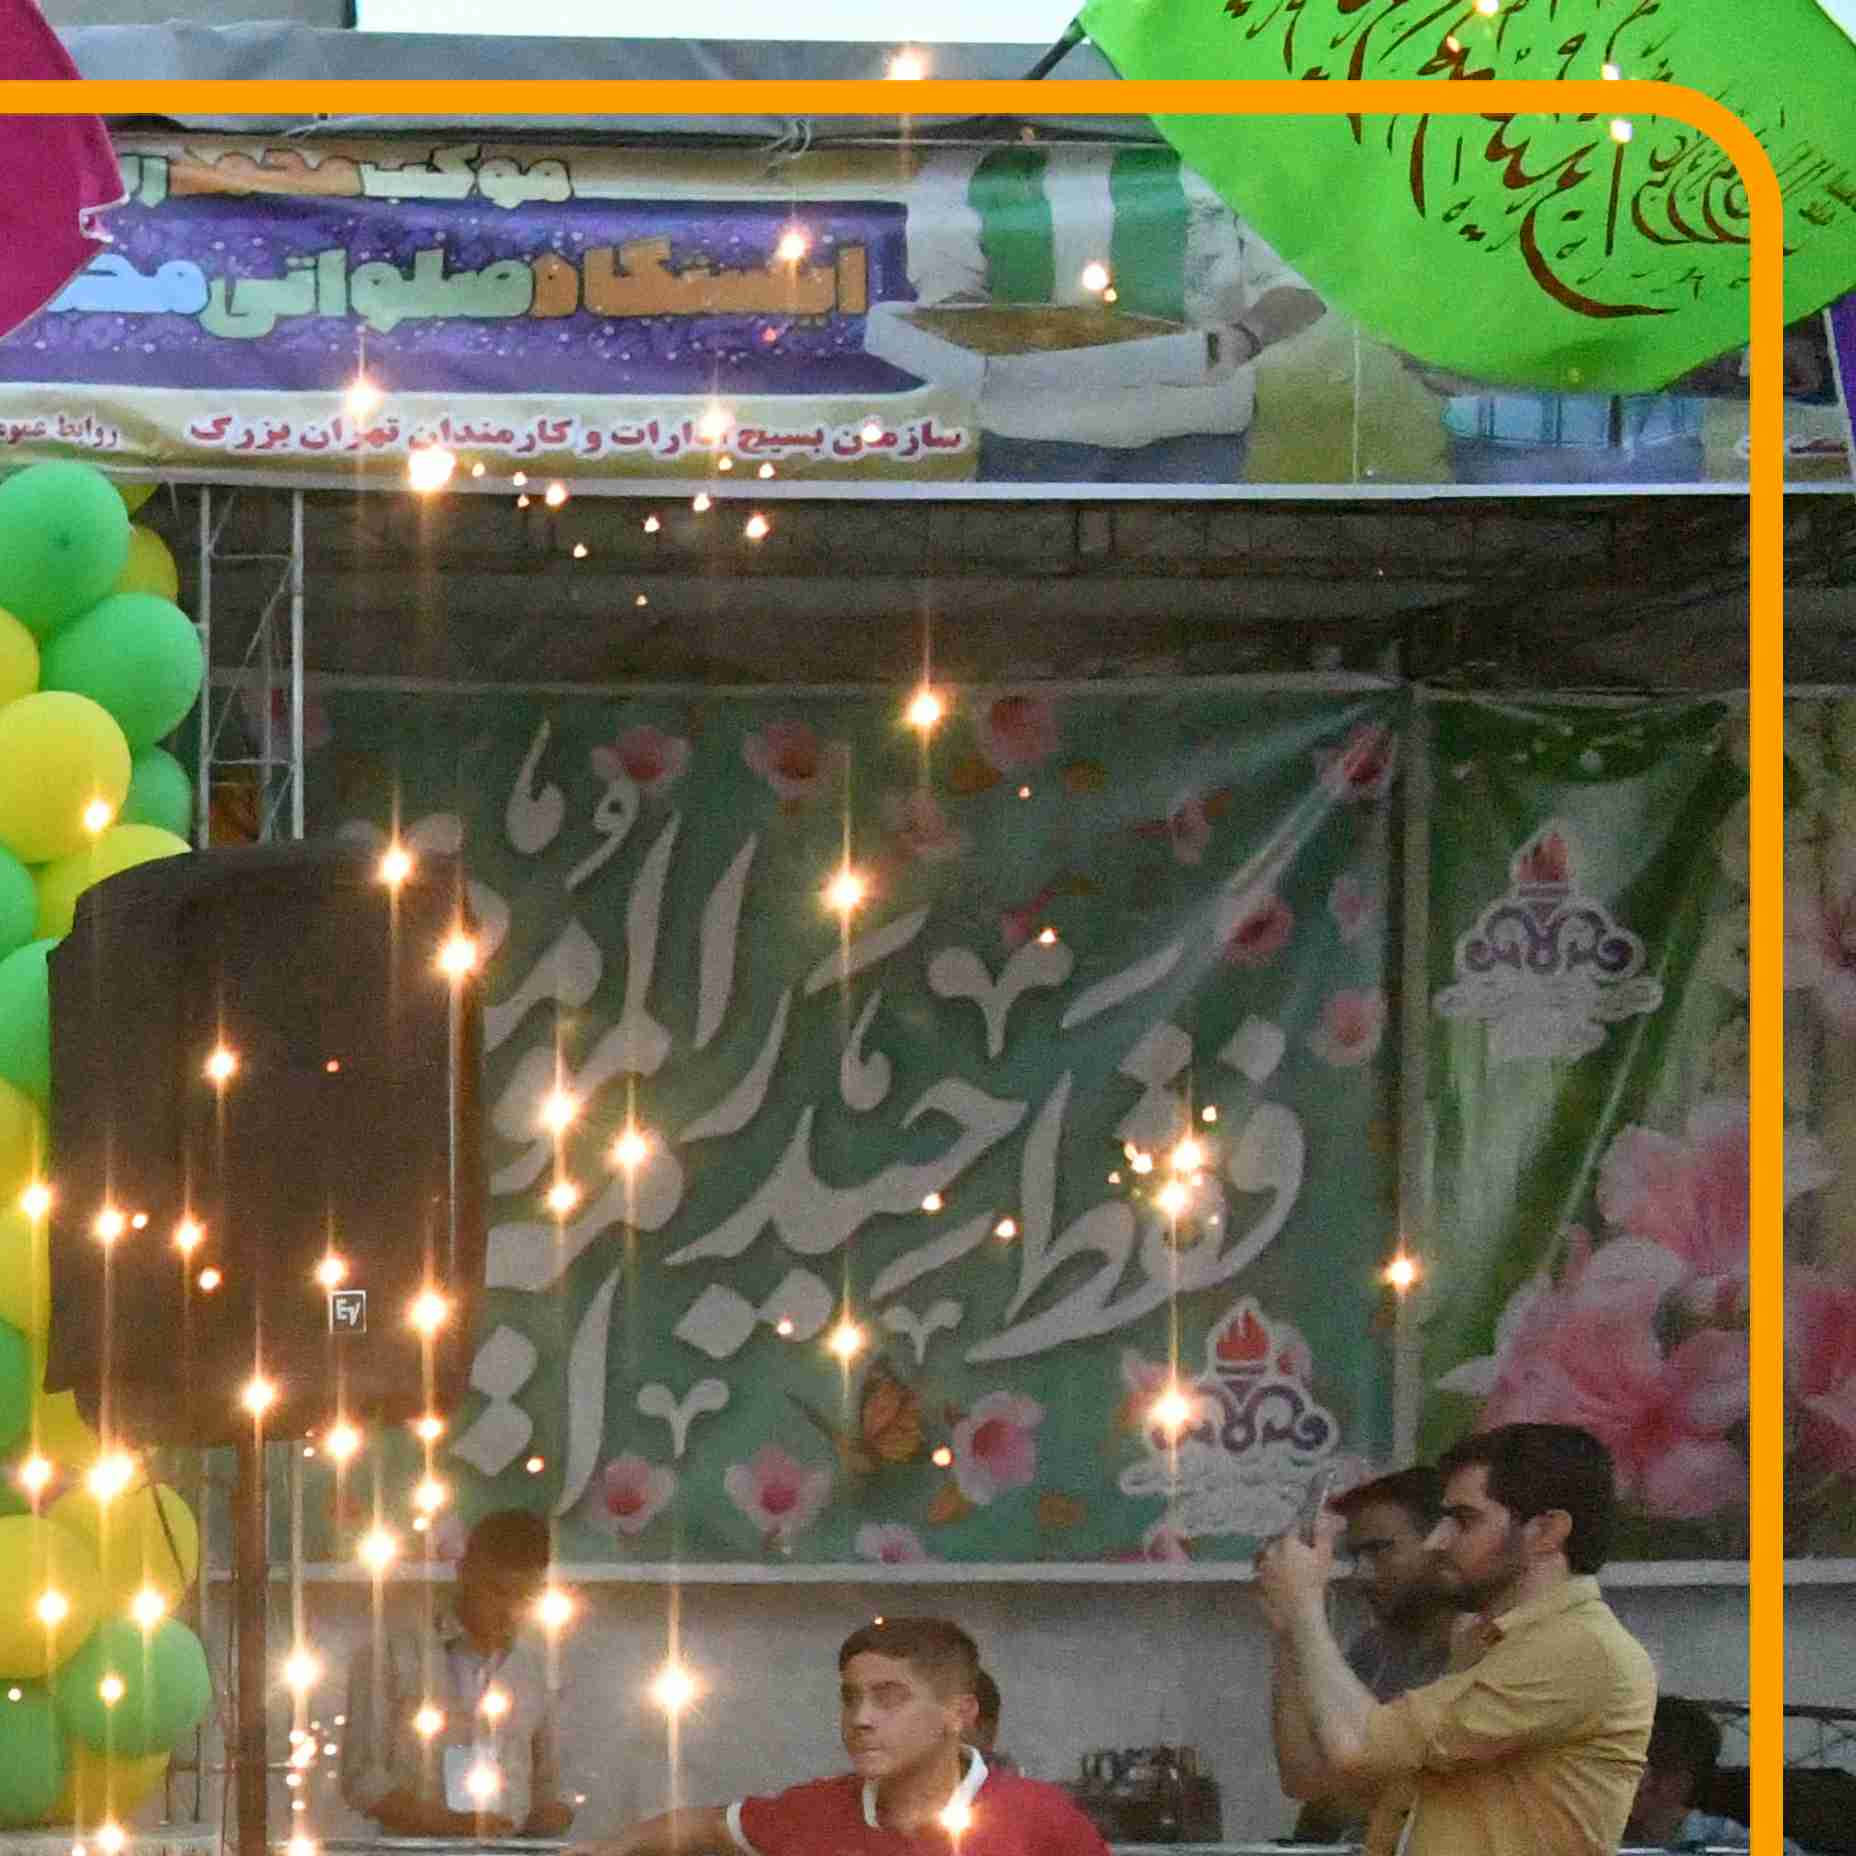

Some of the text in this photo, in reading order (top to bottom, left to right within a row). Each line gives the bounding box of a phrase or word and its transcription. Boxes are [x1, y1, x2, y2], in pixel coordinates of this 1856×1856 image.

[198, 247, 533, 338] صلواتی
[529, 235, 868, 327] ایستگاه
[59, 415, 119, 448] روابط
[191, 416, 291, 450] بزرگ
[583, 427, 603, 453] و
[737, 427, 823, 454] بسیج
